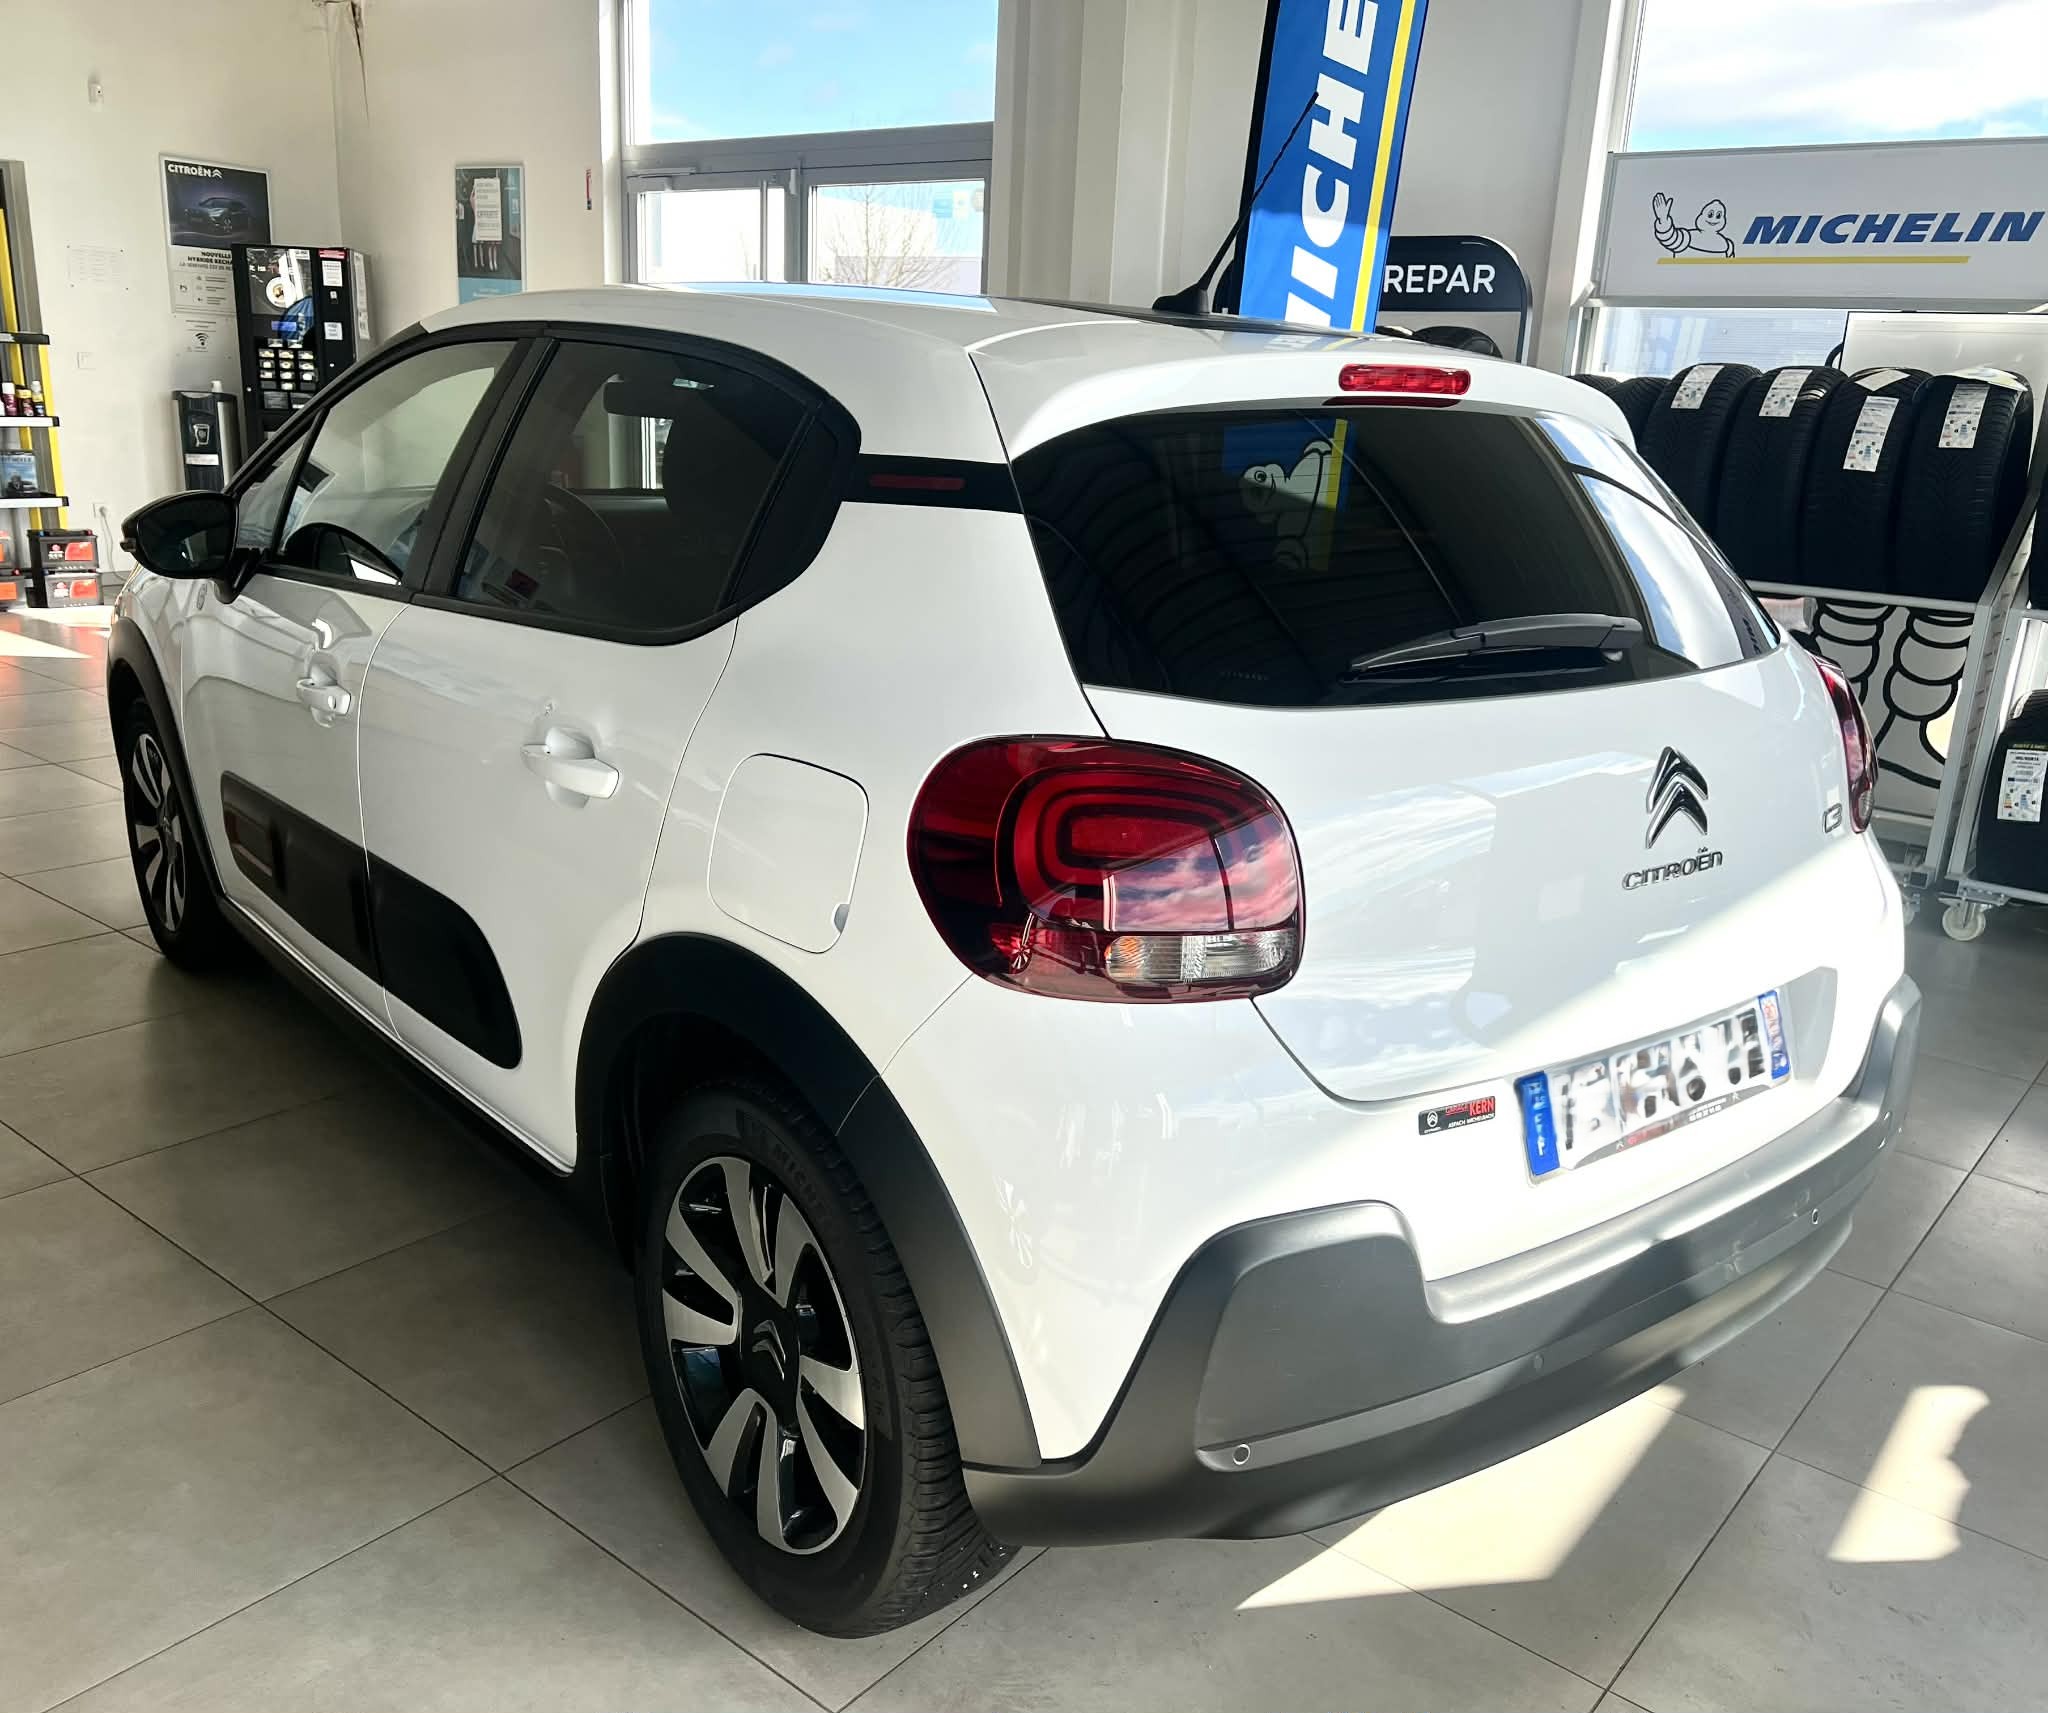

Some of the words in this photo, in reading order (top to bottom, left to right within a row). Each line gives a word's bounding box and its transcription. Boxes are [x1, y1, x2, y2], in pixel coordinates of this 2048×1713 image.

[168, 164, 212, 177] CITROËN
[1742, 211, 2046, 245] MICHELIN
[1383, 264, 1496, 294] REPAR
[1469, 1097, 1495, 1117] KERN
